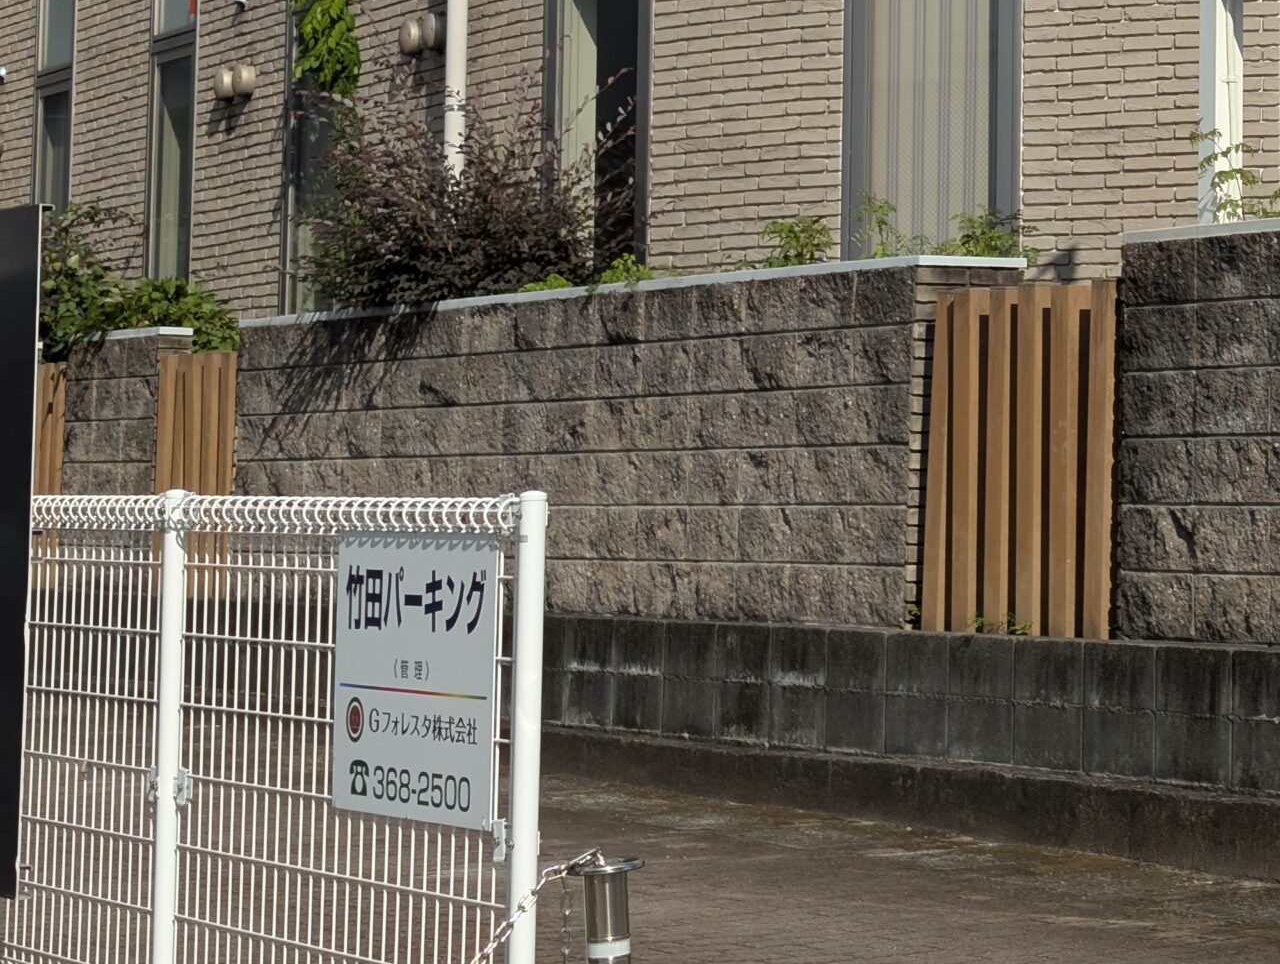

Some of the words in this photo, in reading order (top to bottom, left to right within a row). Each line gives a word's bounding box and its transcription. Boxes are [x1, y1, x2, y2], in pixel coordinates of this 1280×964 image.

[345, 564, 487, 635] 竹田パーキング
[368, 707, 478, 745] Gフォレスタ株式会社
[372, 765, 471, 813] 368-2500
